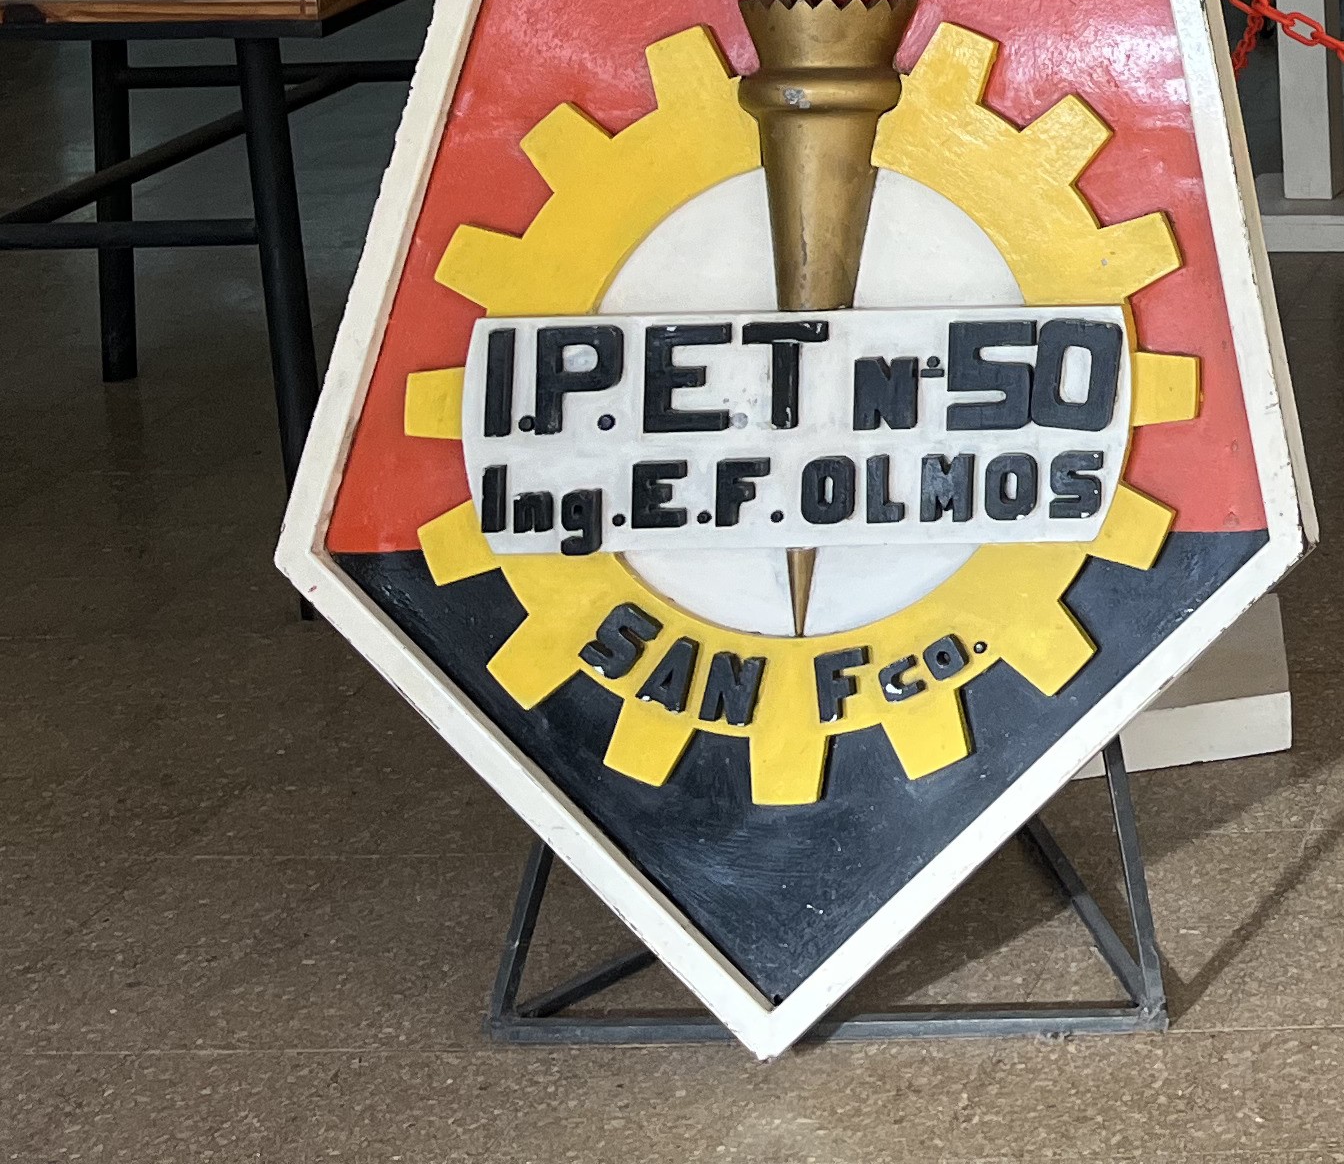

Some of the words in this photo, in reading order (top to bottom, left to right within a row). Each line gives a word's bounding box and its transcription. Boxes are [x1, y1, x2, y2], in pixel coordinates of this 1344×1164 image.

[945, 318, 1124, 432] 50
[801, 449, 1105, 525] OLMOS
[577, 602, 766, 726] SAN
